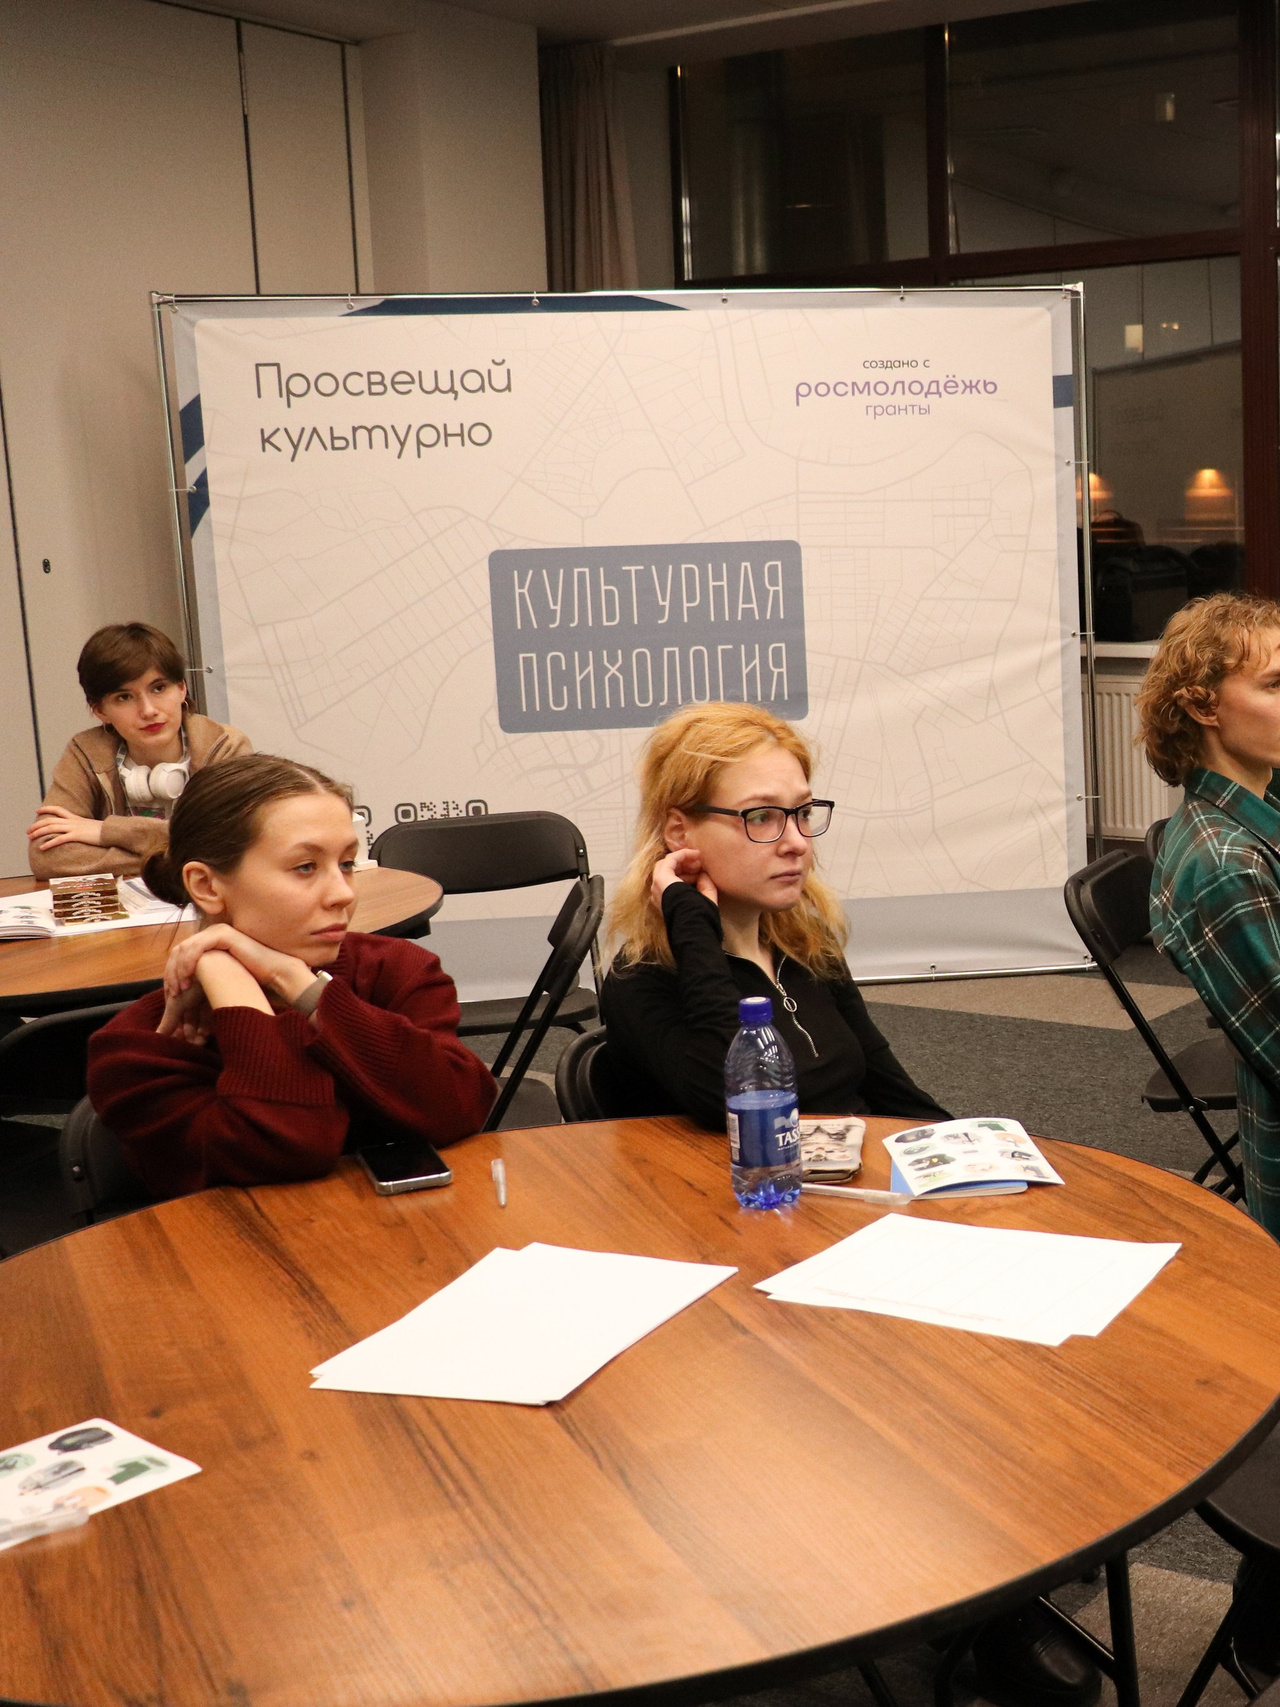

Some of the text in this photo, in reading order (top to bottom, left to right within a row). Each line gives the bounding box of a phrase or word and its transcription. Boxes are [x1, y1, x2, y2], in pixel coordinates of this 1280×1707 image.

[255, 358, 512, 408] Просвещай
[862, 359, 930, 370] создано с
[795, 374, 998, 407] росмолодёжь
[865, 404, 931, 420] гранты
[260, 422, 493, 462] культурно
[513, 560, 784, 630] КУЛЬТУРНАЯ
[518, 643, 789, 712] ПСИХОЛОГИЯ
